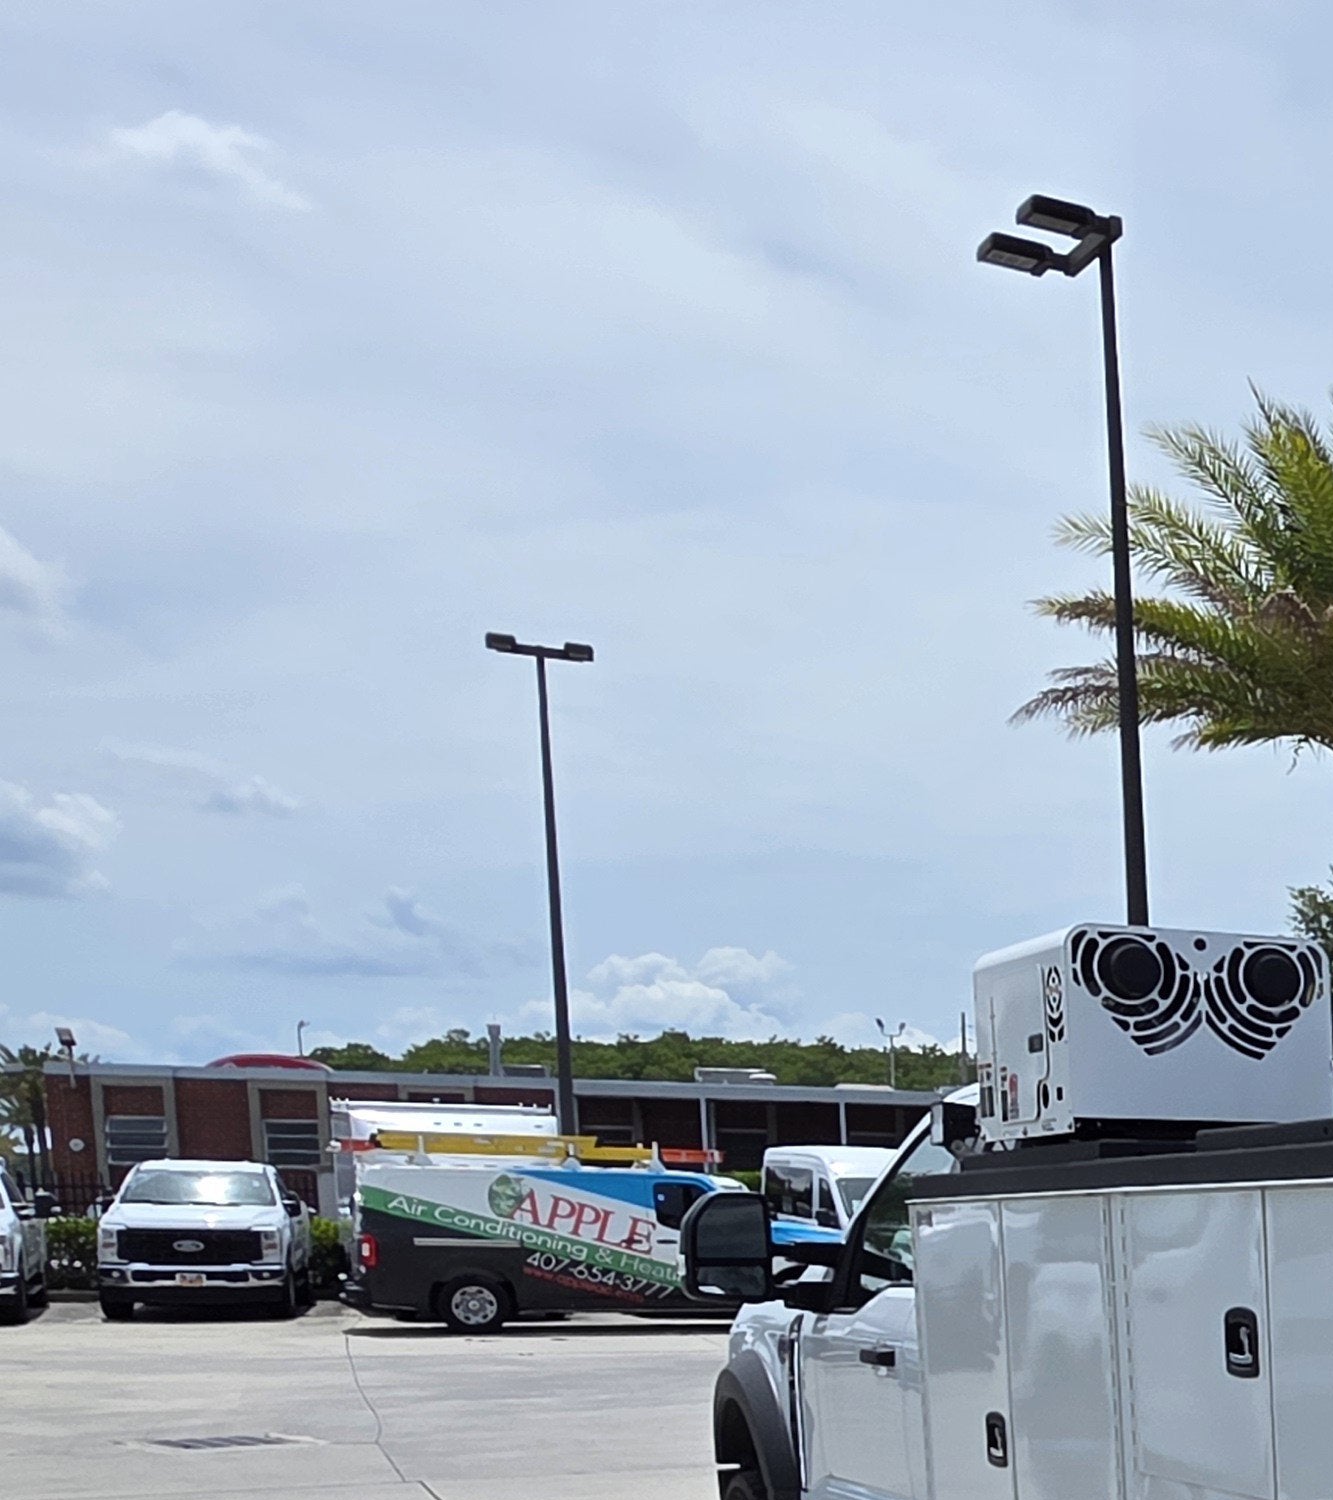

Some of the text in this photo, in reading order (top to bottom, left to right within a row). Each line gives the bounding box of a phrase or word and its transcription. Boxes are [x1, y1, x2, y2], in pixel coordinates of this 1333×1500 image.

[387, 1197, 429, 1217] Air
[434, 1207, 588, 1261] Conditioning
[594, 1249, 613, 1264] &
[509, 1188, 657, 1255] APPLE
[526, 1252, 675, 1299] 407-654-3777
